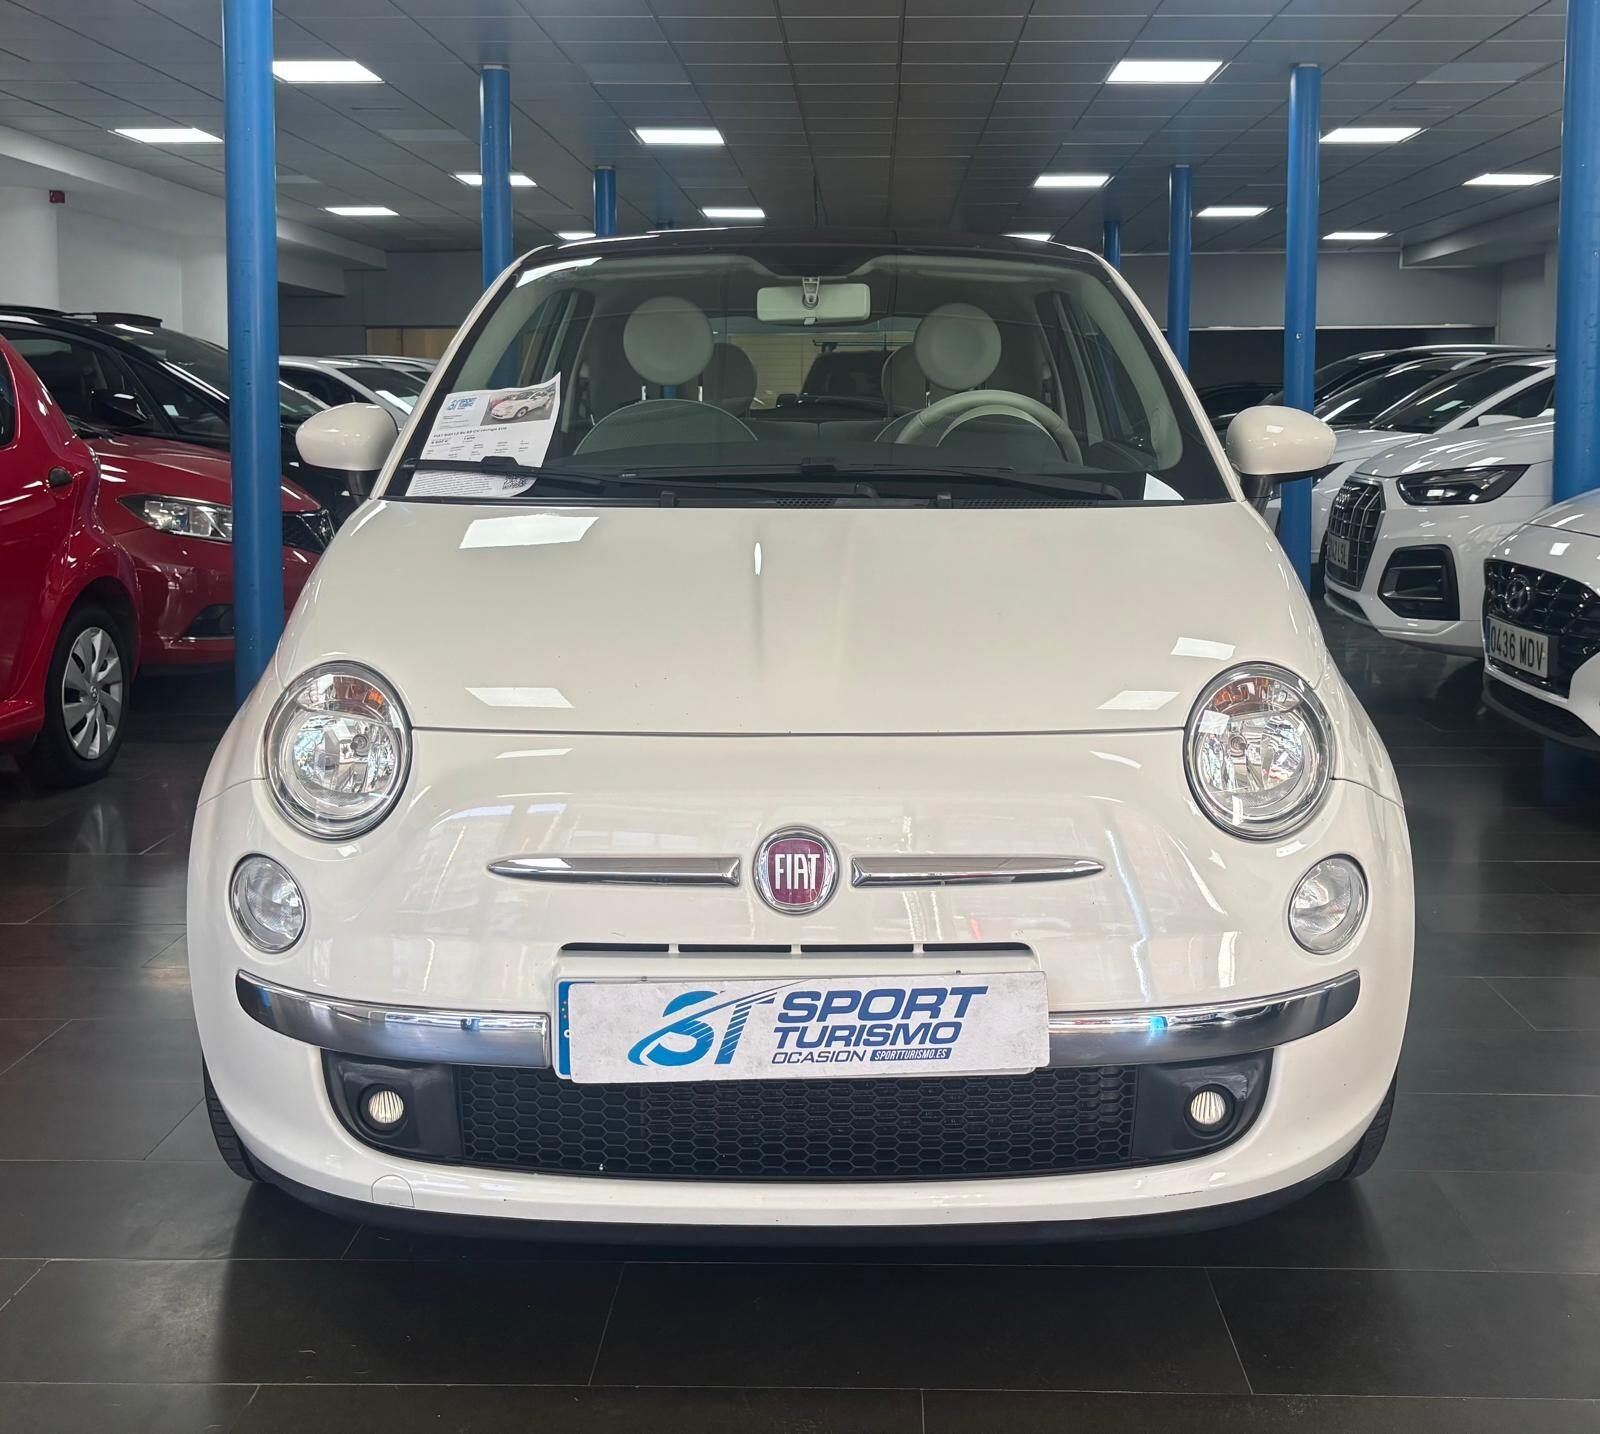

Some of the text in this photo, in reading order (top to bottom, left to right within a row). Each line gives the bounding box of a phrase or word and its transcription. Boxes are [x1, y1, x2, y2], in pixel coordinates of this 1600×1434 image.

[1491, 626, 1544, 671] 0436 MDV
[774, 853, 821, 890] FIAT
[777, 986, 989, 1024] SPORT
[773, 1021, 963, 1050] TURISMO
[771, 1048, 947, 1065] OCASION SPORTTURISMO.ES
